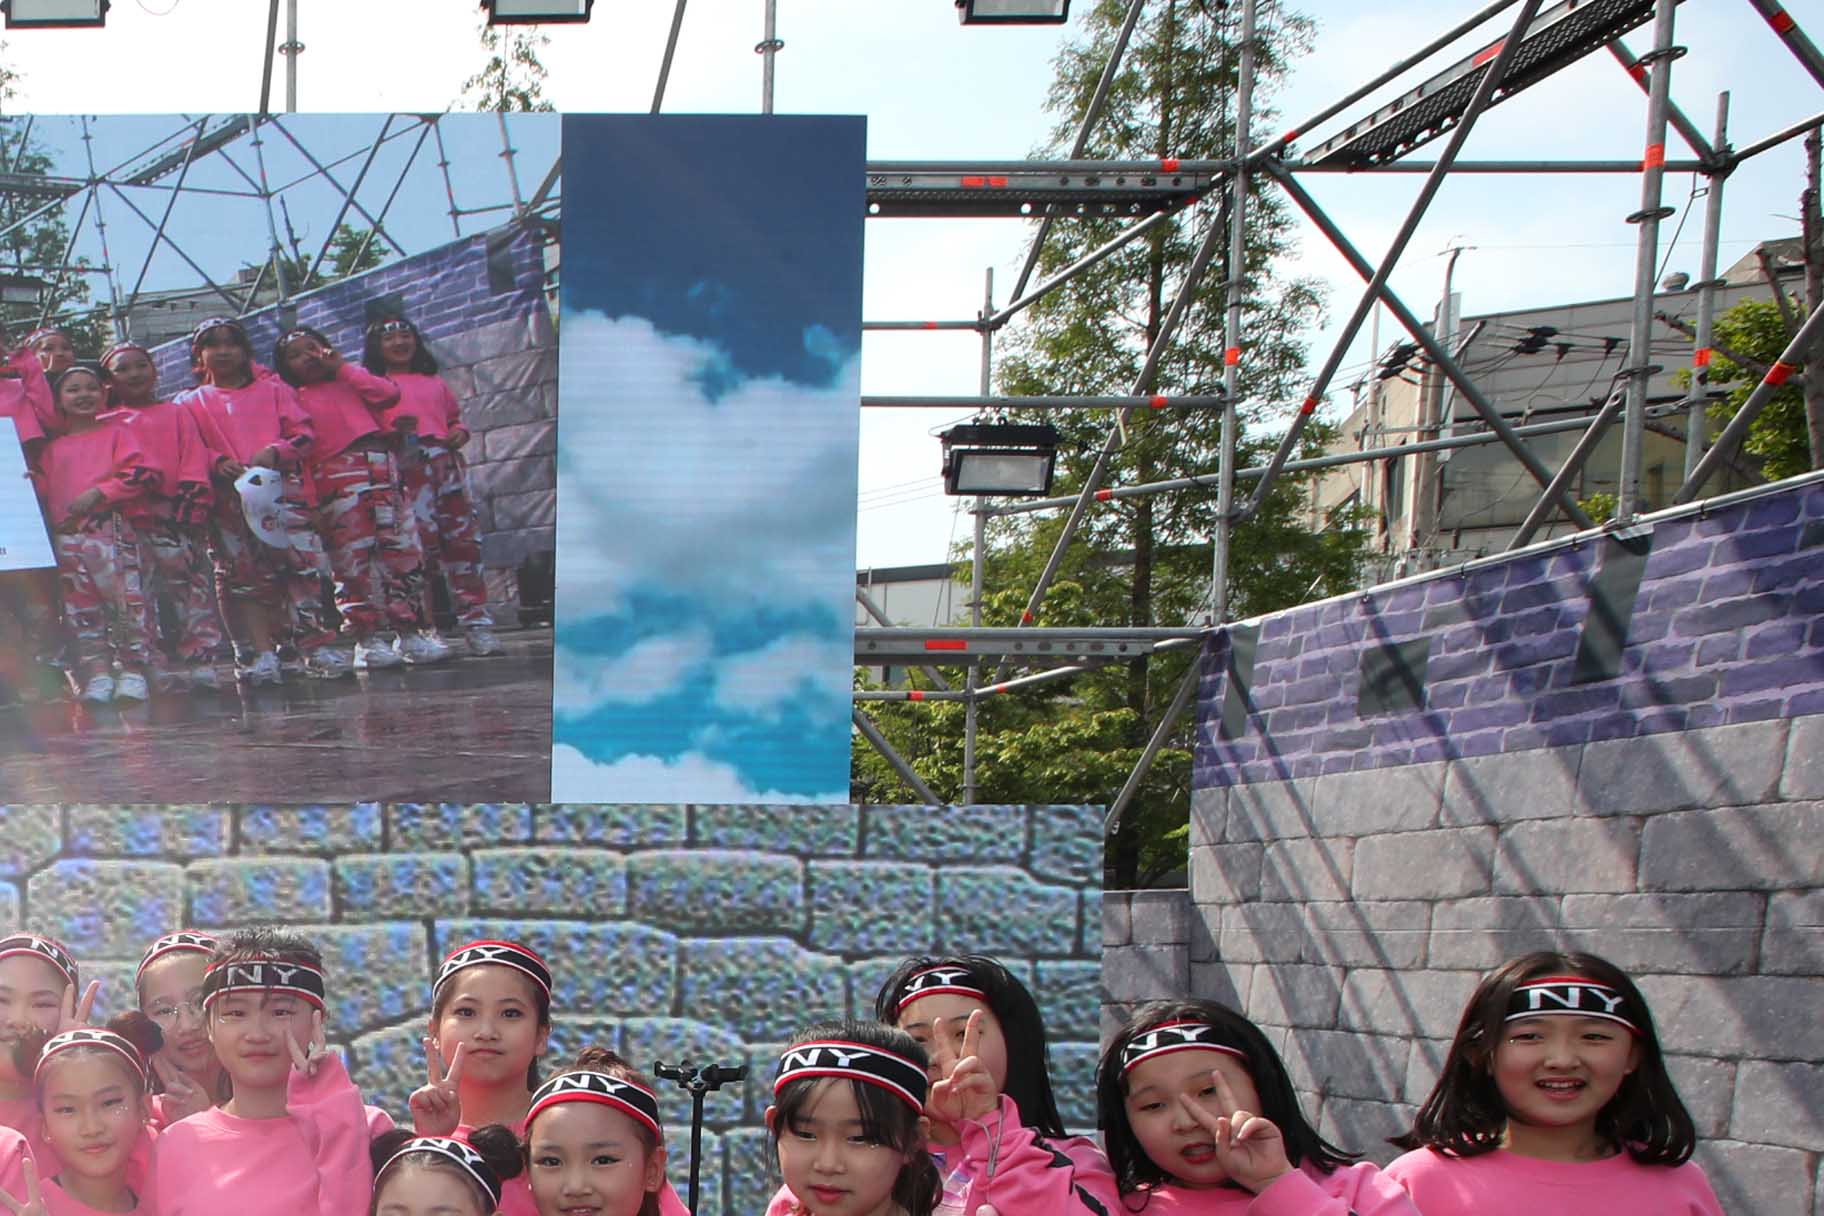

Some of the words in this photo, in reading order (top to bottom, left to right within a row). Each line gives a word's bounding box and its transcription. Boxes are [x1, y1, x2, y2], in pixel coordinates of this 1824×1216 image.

[227, 965, 299, 985] NY
[441, 949, 511, 977] NY
[1529, 987, 1623, 1013] NY
[43, 1031, 116, 1055] NY
[1123, 1027, 1212, 1063] NY
[783, 1049, 872, 1072] NY
[552, 1075, 627, 1093] NY
[410, 1140, 485, 1164] NY
